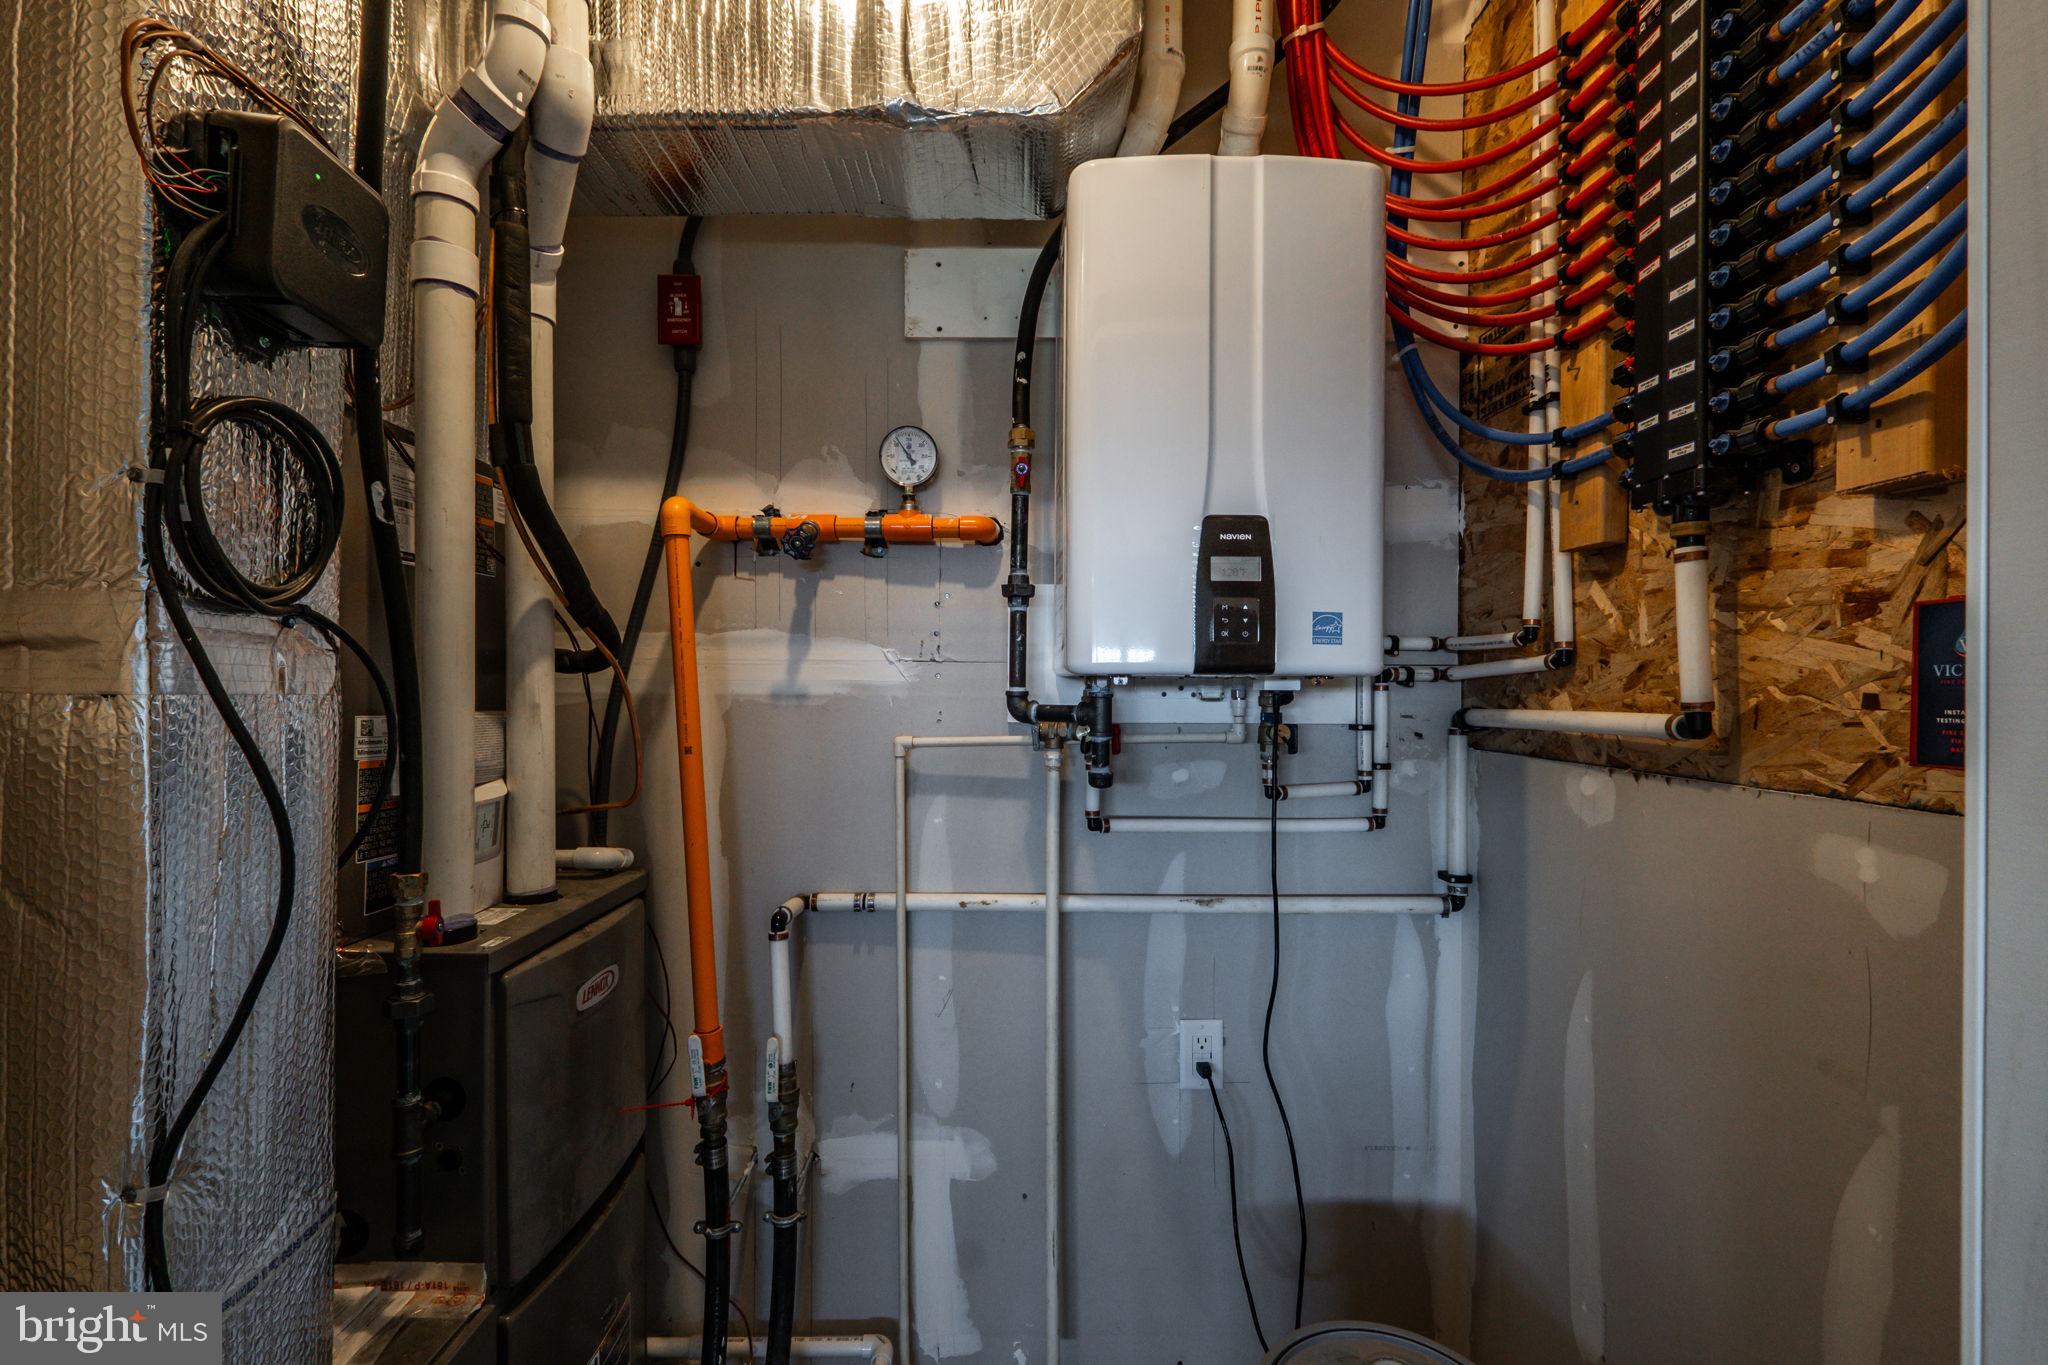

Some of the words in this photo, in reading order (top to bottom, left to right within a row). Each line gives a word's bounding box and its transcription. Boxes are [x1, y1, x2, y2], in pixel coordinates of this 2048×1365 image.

[1254, 0, 1262, 33] PIP
[1933, 664, 1965, 677] VIC
[582, 972, 610, 1005] LENNOX
